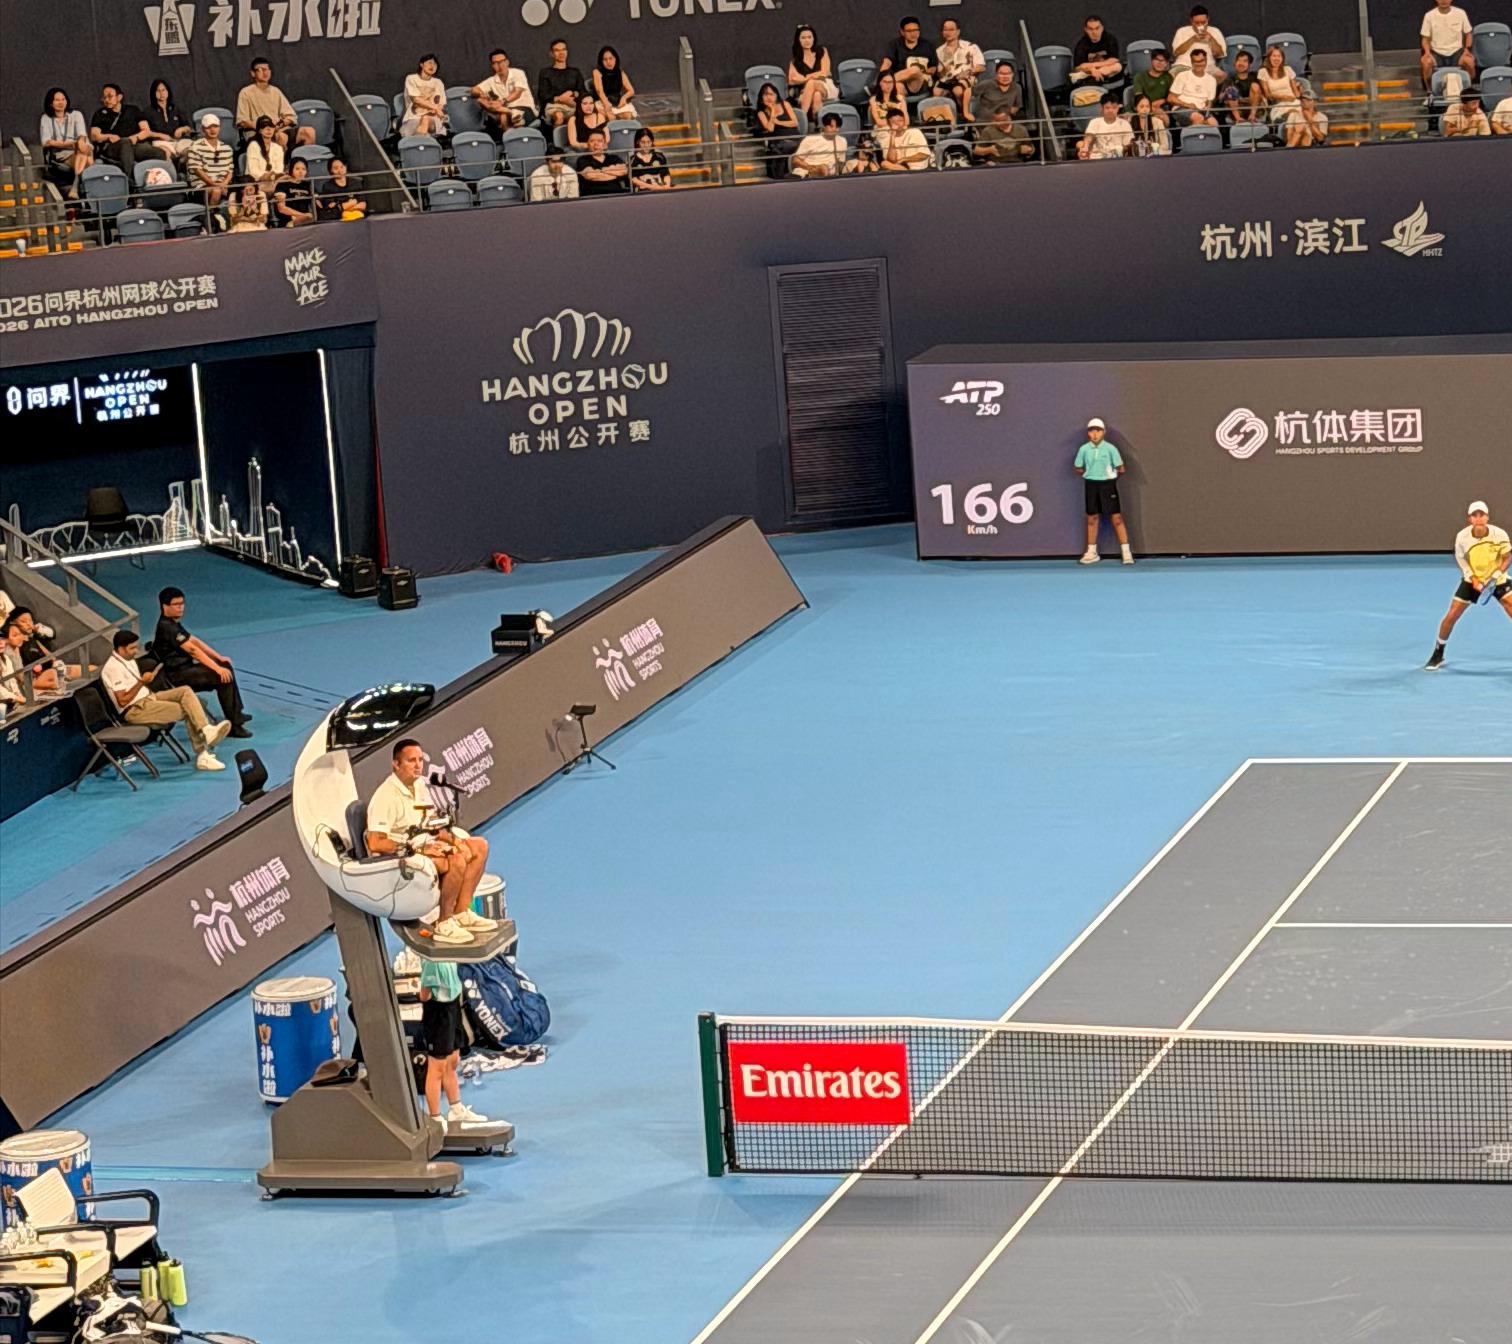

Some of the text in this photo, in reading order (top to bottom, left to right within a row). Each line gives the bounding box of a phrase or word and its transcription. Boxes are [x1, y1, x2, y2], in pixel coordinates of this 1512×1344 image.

[1200, 217, 1369, 262] 杭州·滨江
[284, 246, 328, 276] MAKE
[286, 265, 325, 294] YOUR
[298, 279, 330, 306] ACE
[33, 314, 72, 330] AITO
[76, 303, 169, 325] HANGZHOU
[173, 297, 219, 314] OPEN
[27, 383, 71, 410] 问界
[84, 378, 168, 400] HANGZHOU
[481, 361, 669, 403] HANGZHOU
[939, 380, 1005, 403] ATP
[105, 393, 150, 410] OPEN
[528, 394, 628, 426] OPEN
[976, 402, 1001, 416] 250
[509, 419, 651, 456] 杭州公开赛
[1275, 407, 1423, 445] 杭体集团
[930, 482, 1035, 526] 166
[967, 523, 999, 535] Km/h
[244, 886, 291, 924] HANGZHOU
[252, 909, 286, 938] SPORTS
[474, 999, 510, 1042] YONEX
[739, 1062, 901, 1099] Emirates
